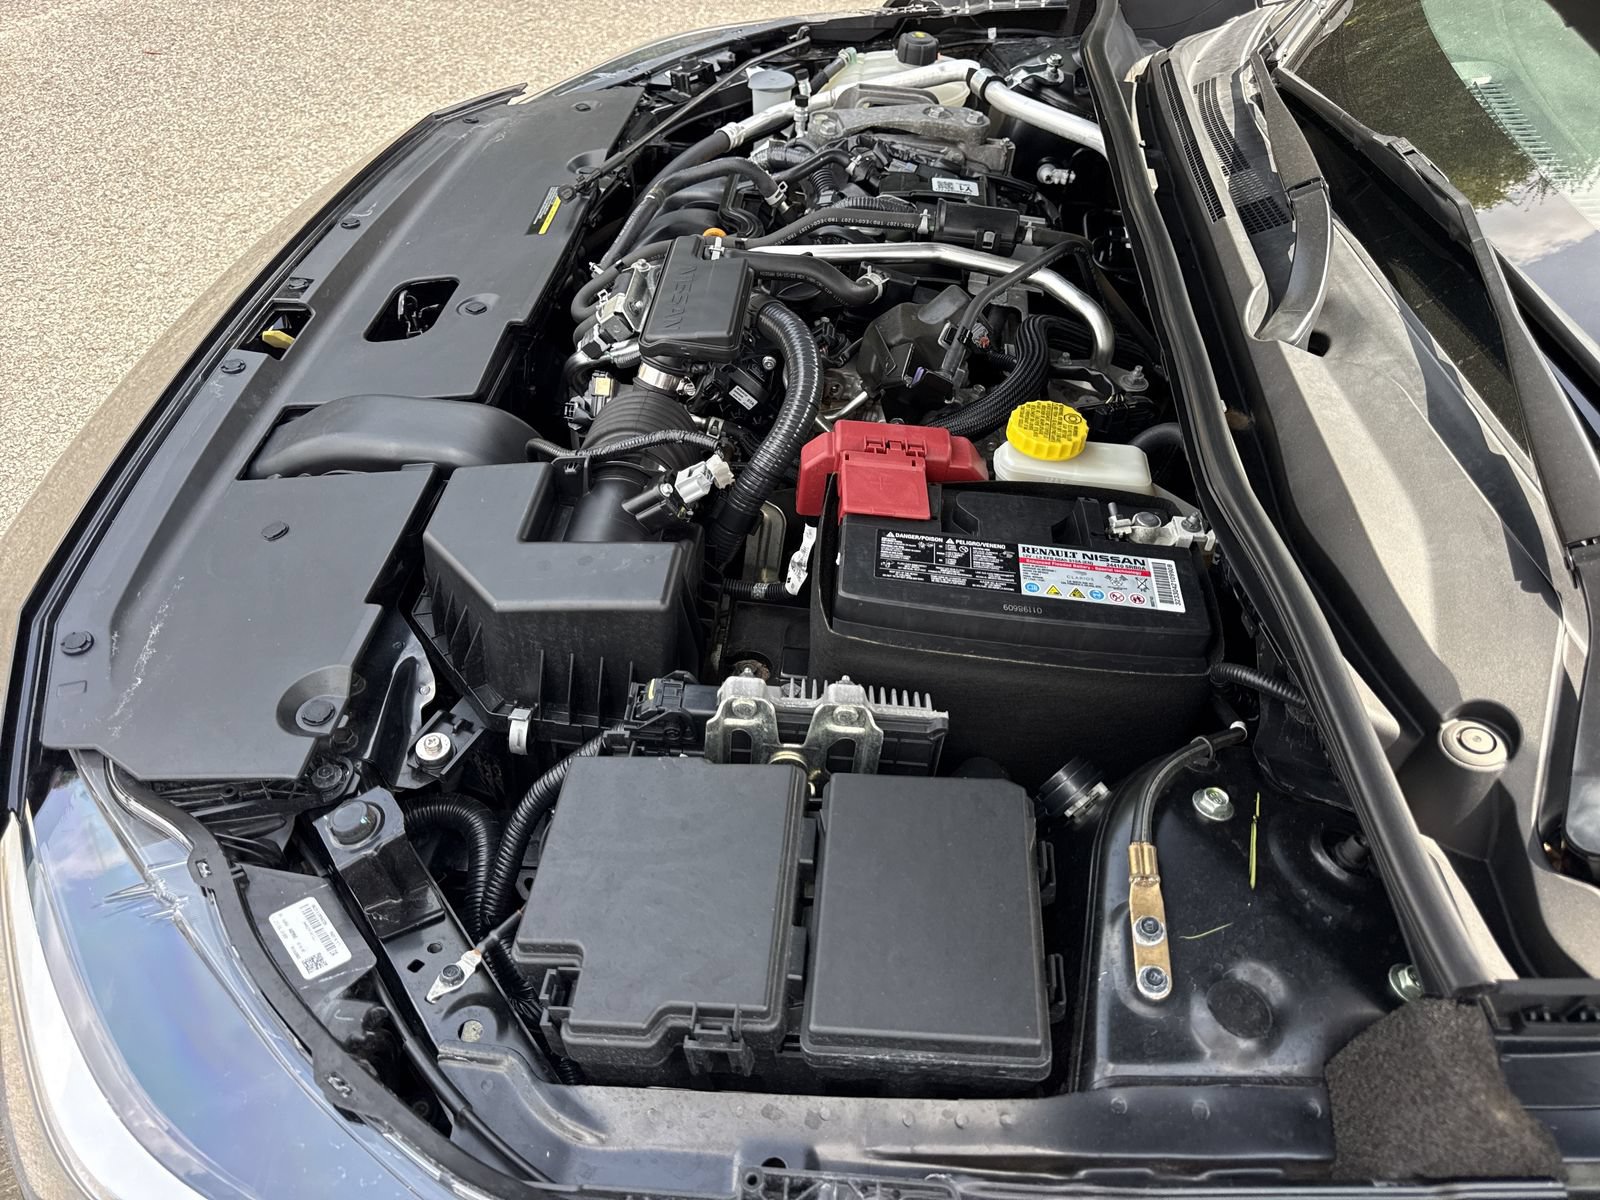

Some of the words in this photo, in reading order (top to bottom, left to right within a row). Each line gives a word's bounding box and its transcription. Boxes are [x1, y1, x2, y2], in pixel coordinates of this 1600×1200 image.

[663, 265, 698, 330] NISSAN
[895, 532, 944, 543] DANGER/POISON
[955, 539, 1006, 550] PELIGRO/VENENO
[1021, 546, 1078, 559] RENAULT
[1082, 553, 1146, 566] NISSAN
[1066, 574, 1095, 582] CLARIOS
